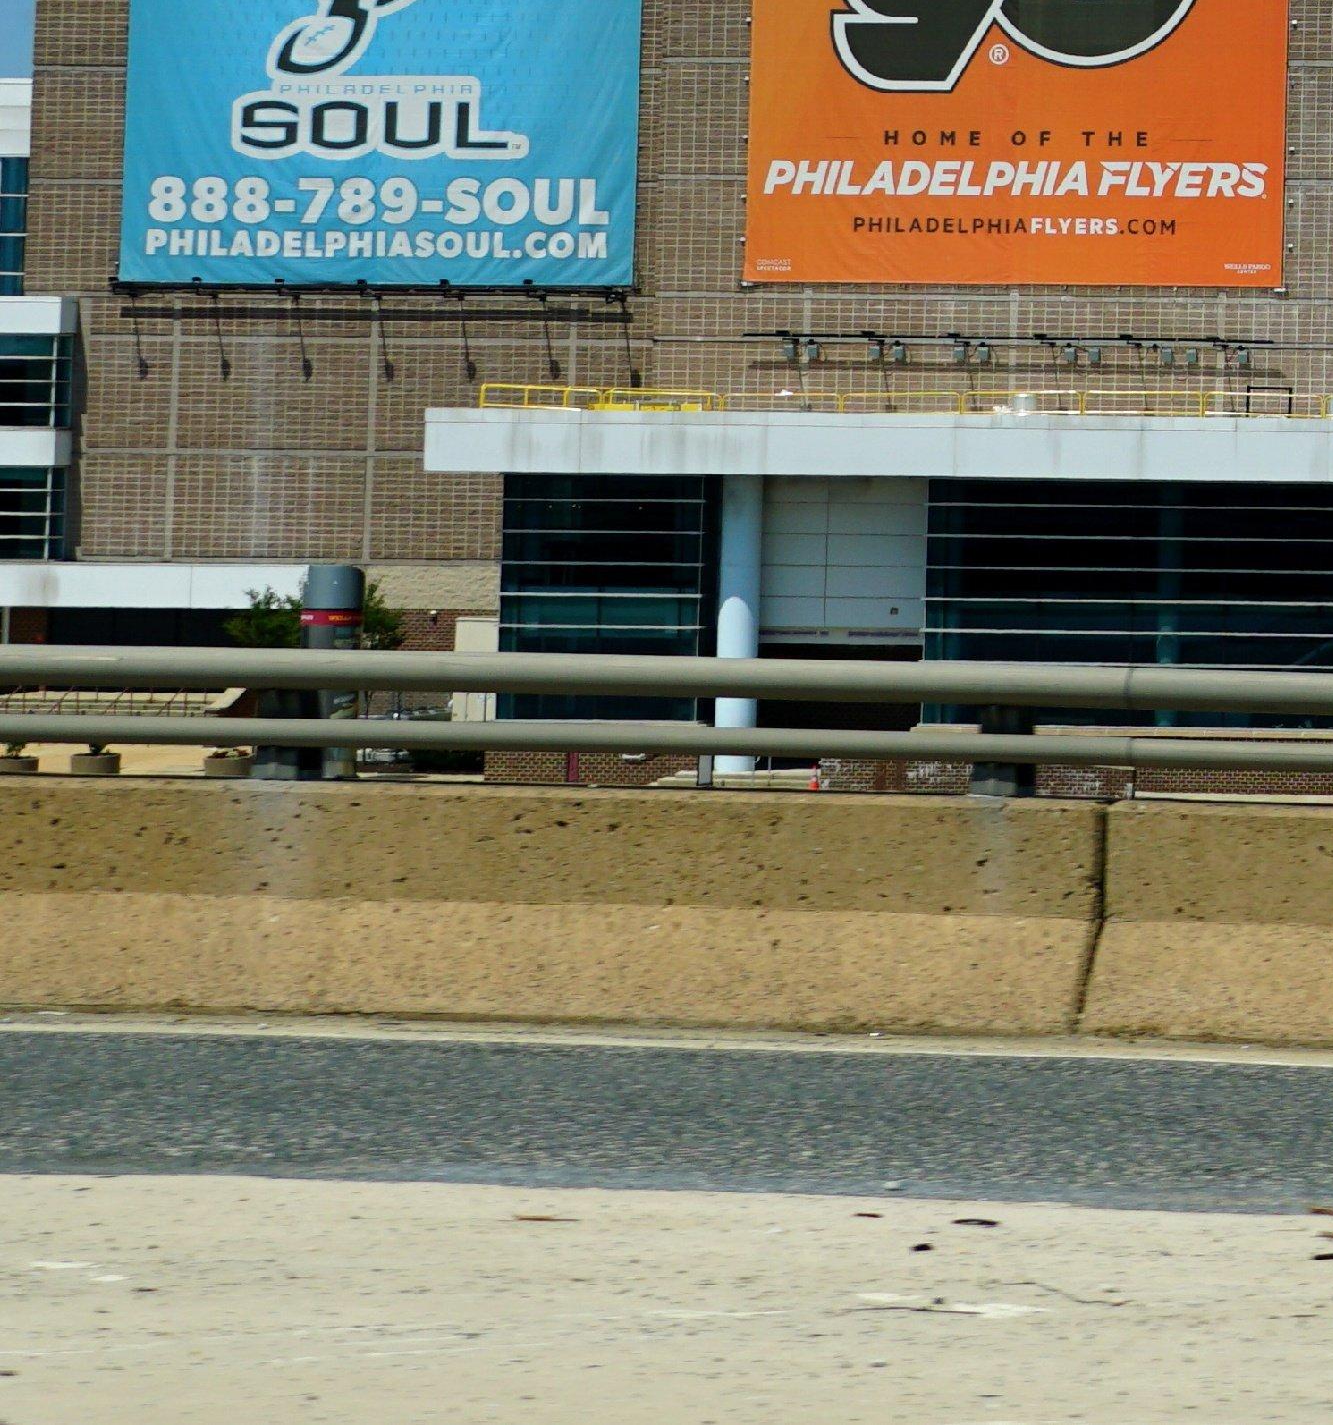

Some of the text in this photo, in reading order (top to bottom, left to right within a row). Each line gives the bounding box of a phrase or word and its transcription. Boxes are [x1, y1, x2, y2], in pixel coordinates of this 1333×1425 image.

[279, 84, 473, 95] PHILADELPHIA
[241, 100, 508, 149] SOUL
[884, 130, 1149, 147] HOME OF THE
[763, 160, 1269, 198] PHILADELPHIA FLYERS
[147, 176, 610, 226] 888-789-SOUL
[853, 216, 1177, 236] PHILADELPHIAFLYERS.COM
[145, 228, 608, 259] PHILADELPHIASOUL.COM
